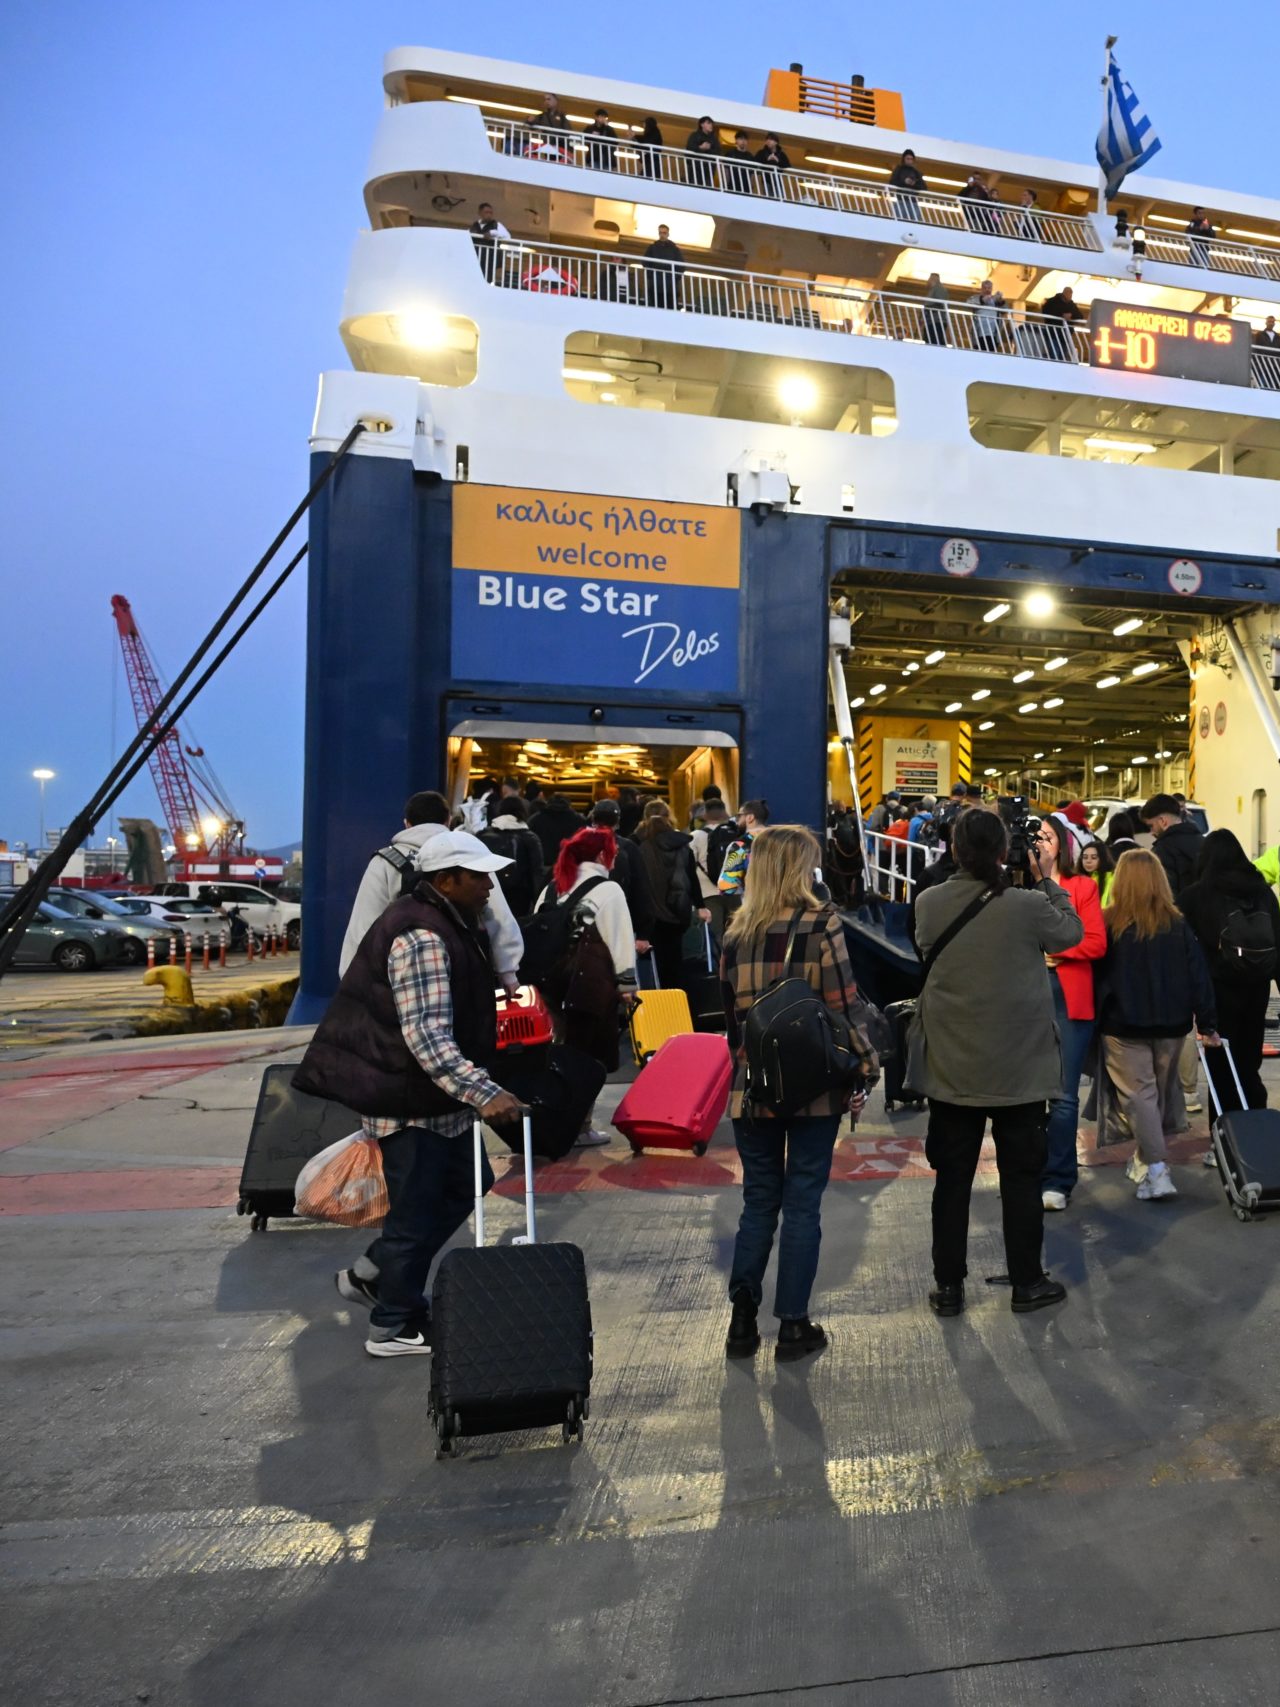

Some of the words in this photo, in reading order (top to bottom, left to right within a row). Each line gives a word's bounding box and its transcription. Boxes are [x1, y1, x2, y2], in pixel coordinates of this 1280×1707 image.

[496, 500, 592, 531] καλώς
[604, 506, 707, 537] ήλθατε
[537, 543, 667, 571] welcome
[478, 575, 567, 611] Blue
[580, 583, 659, 617] Star
[621, 622, 720, 684] Delos
[897, 745, 930, 755] Attica
